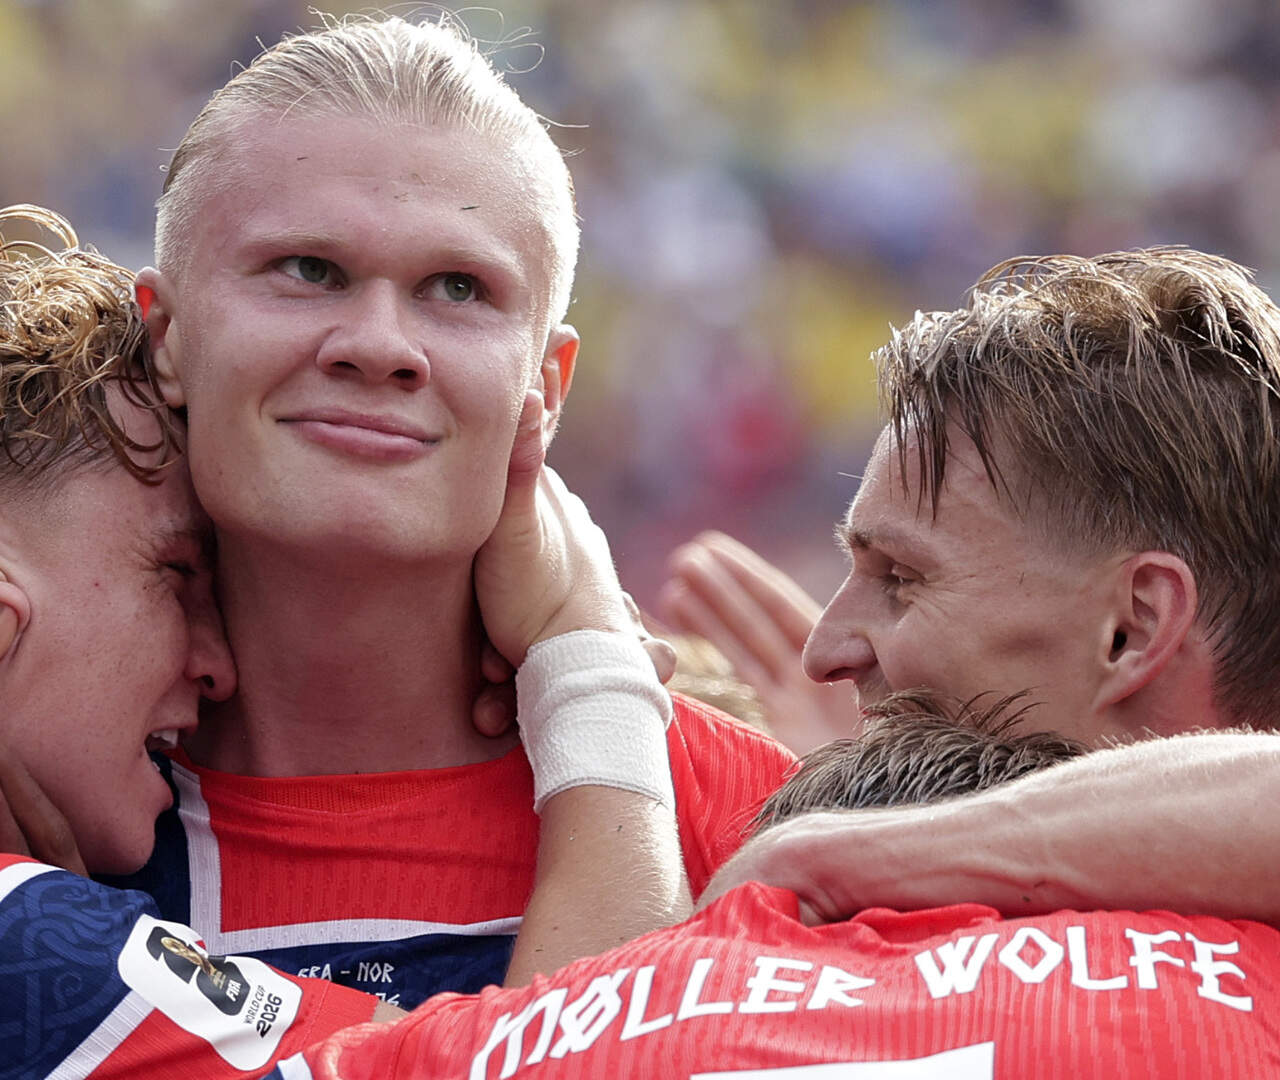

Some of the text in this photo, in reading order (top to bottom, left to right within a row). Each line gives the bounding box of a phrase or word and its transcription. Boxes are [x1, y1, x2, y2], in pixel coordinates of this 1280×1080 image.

[357, 962, 394, 983] NOR
[914, 926, 1252, 1011] WOLFE
[225, 979, 242, 1002] FIFA
[243, 984, 267, 1024] WORLD CUP
[256, 993, 283, 1038] 2026
